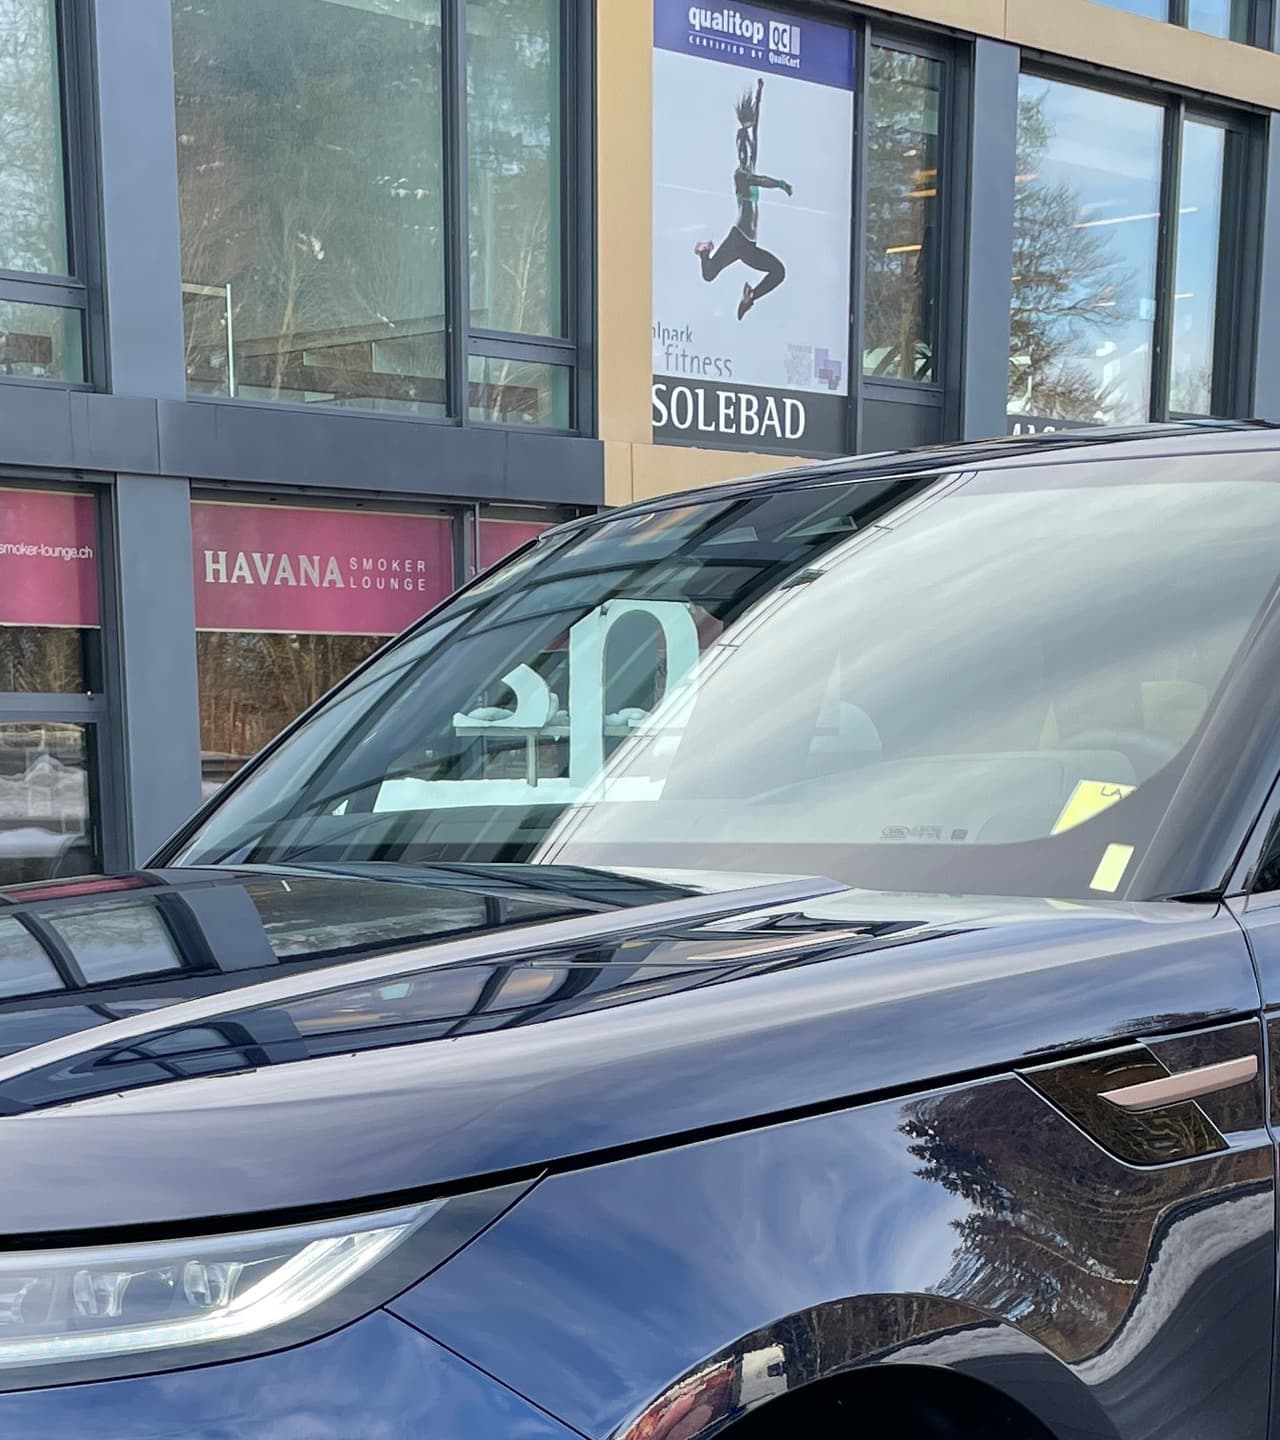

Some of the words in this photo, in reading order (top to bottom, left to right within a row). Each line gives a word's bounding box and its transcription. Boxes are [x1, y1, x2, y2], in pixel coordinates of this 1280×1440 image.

[688, 7, 764, 43] qualitop
[689, 35, 745, 56] CERTIFIED
[751, 49, 764, 60] BY
[768, 52, 801, 69] QualiCert
[664, 344, 733, 378] fitness
[652, 383, 807, 440] SOLEBAD
[204, 551, 345, 588] HAVANA
[349, 557, 426, 573] SMOKER
[350, 577, 426, 592] LOUNGE
